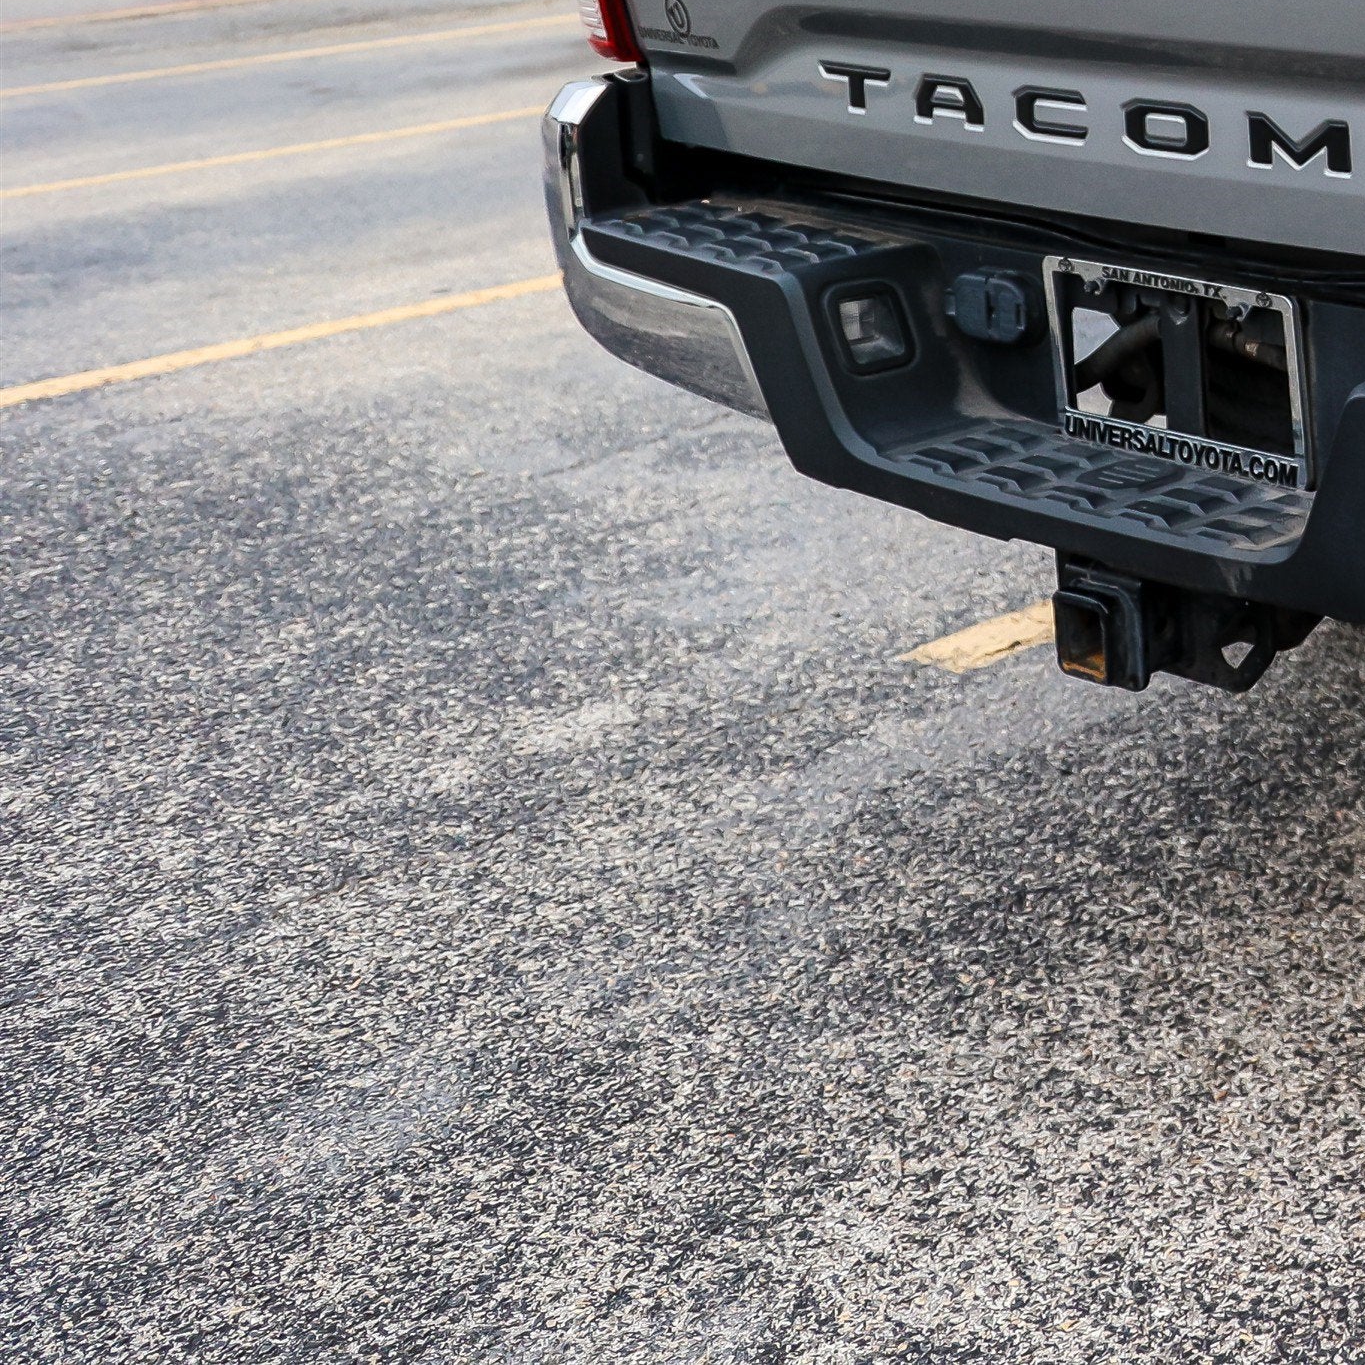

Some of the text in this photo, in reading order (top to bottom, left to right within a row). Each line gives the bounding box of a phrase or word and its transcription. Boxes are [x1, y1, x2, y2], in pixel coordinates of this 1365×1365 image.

[1101, 265, 1130, 282] SAN
[1202, 283, 1224, 299] TX
[1065, 414, 1299, 487] UNIVERSALTOYOTA.COM
